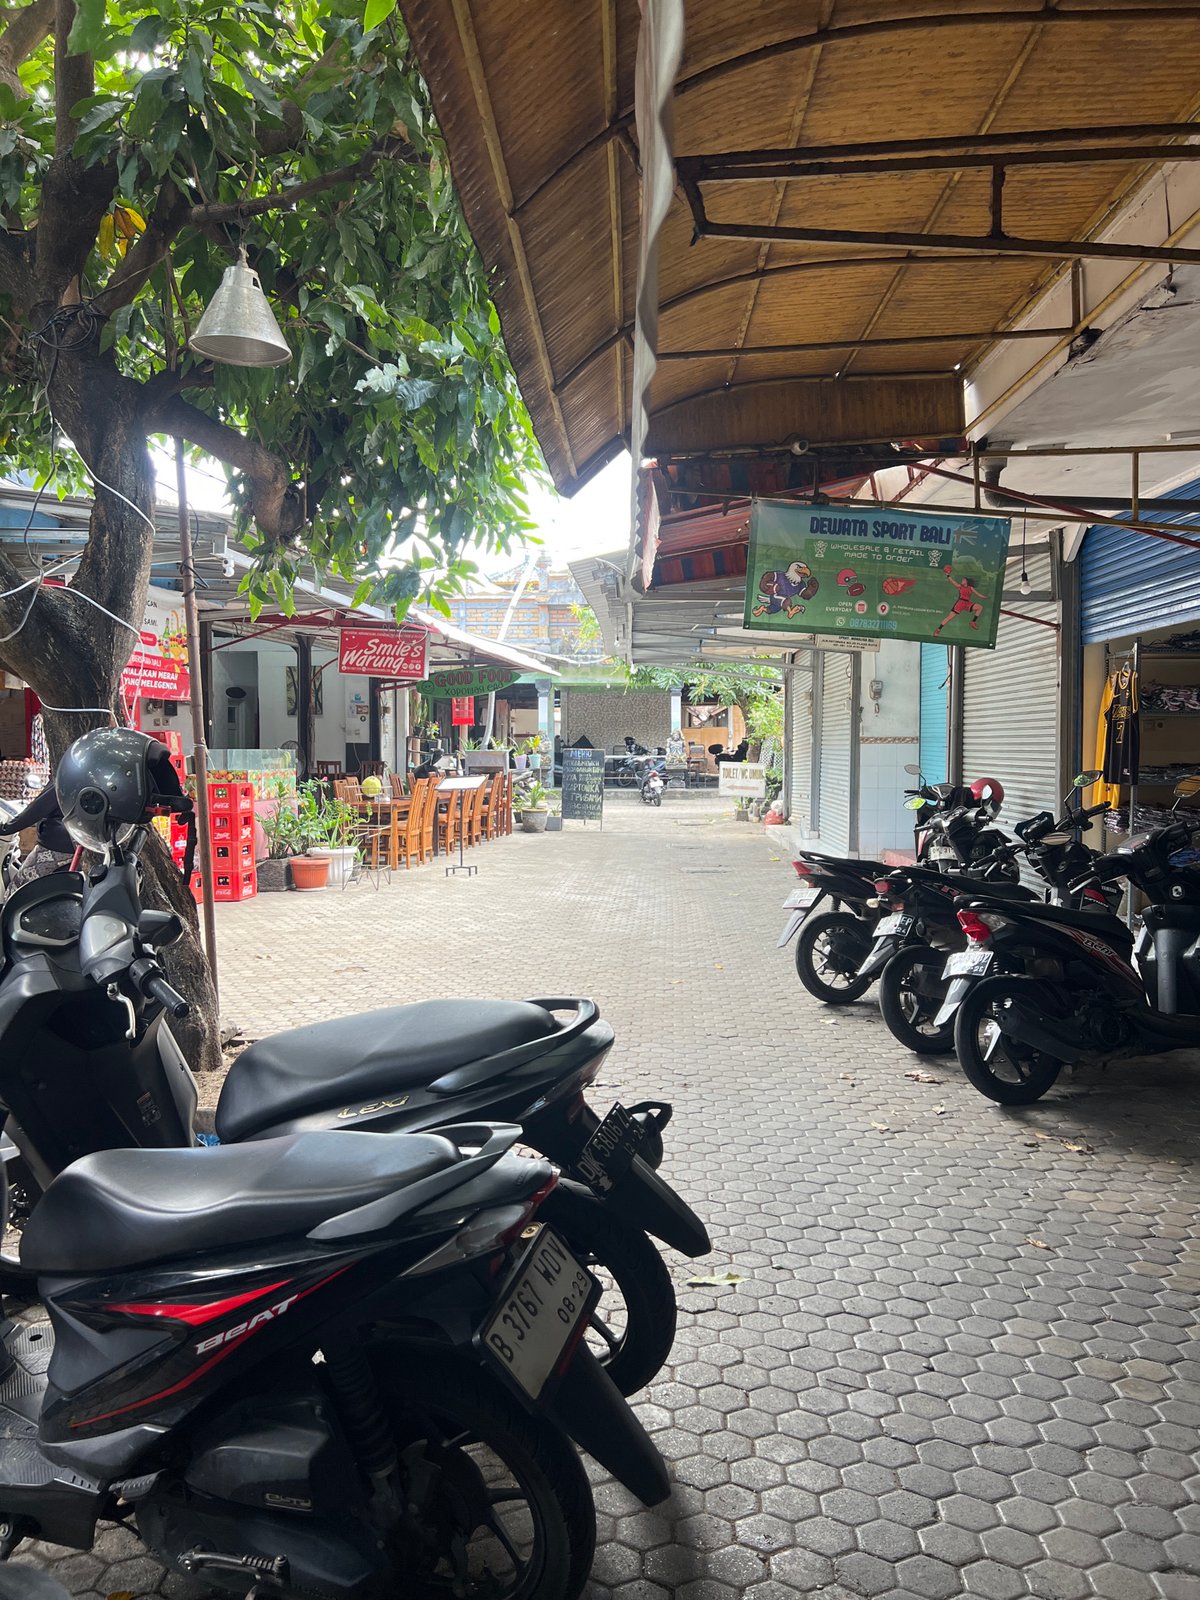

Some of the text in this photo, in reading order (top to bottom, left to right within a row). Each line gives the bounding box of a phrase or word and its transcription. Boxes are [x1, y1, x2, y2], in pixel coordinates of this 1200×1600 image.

[809, 516, 952, 544] DEWATA SPORT BALI
[830, 543, 880, 553] WHOLESALE
[892, 547, 925, 557] RETAIL
[364, 638, 423, 658] Smile's
[341, 649, 406, 675] Warung
[141, 679, 178, 690] MELEGENDA
[435, 669, 513, 688] GOOD FOOD
[576, 1147, 606, 1181] DK
[592, 1118, 623, 1158] 5806
[489, 1332, 515, 1363] B
[502, 1279, 545, 1341] 3767
